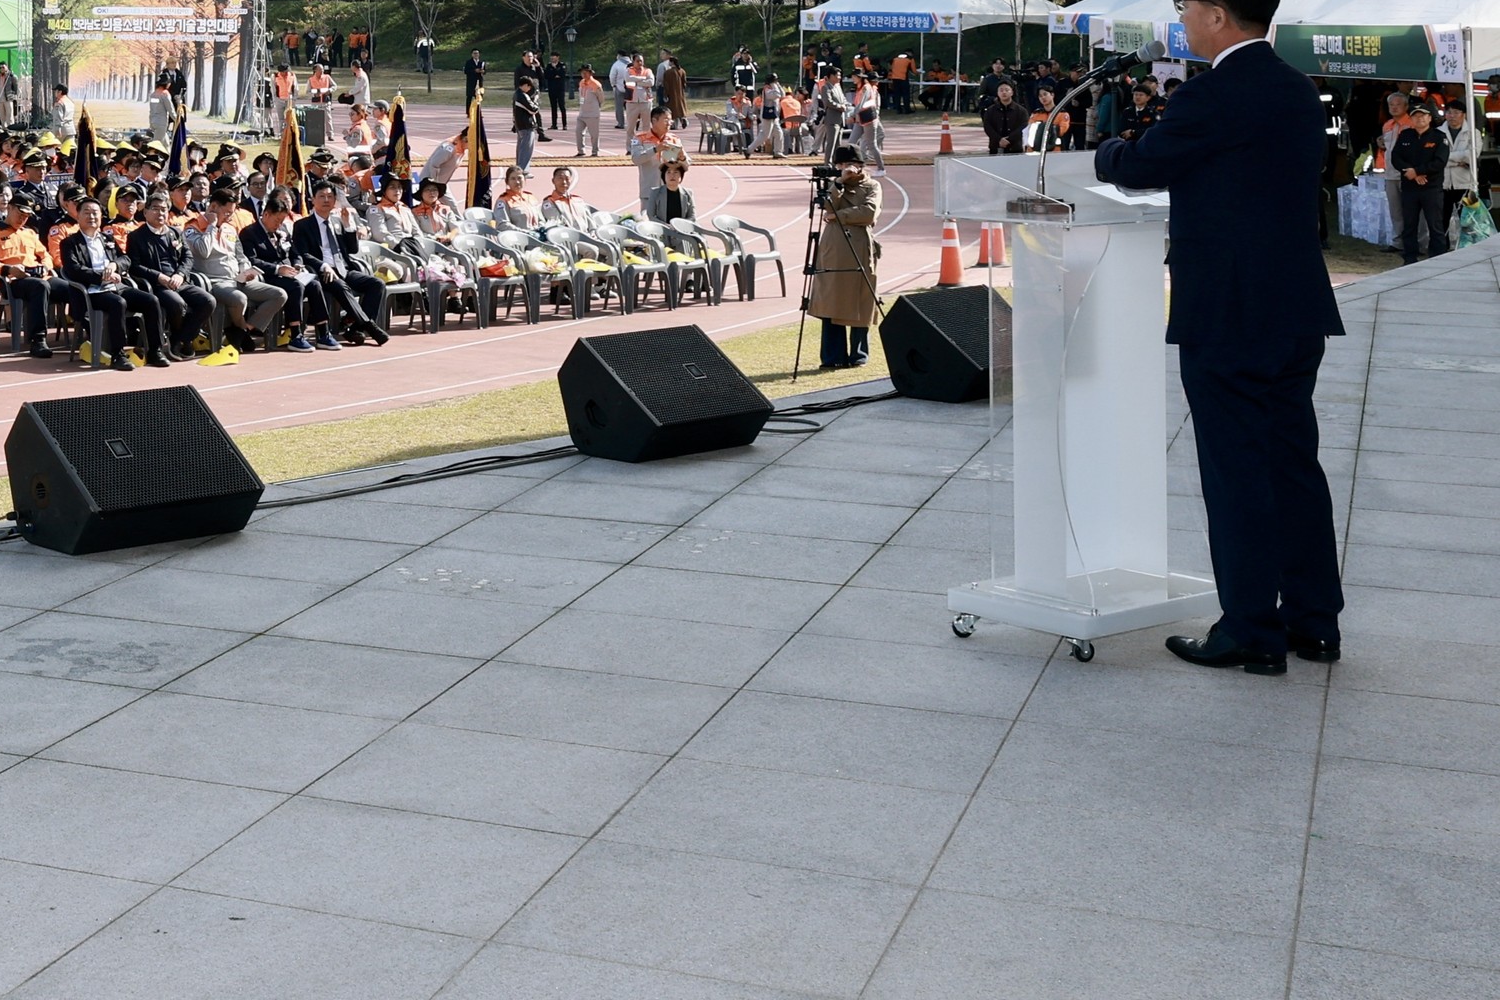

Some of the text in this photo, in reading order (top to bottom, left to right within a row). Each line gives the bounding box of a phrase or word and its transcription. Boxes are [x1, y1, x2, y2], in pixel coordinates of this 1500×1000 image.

[47, 18, 238, 33] 제42회 전라남도 의용소방대 소방기술경연대회
[1345, 35, 1354, 56] 더
[1363, 35, 1382, 57] 담양!
